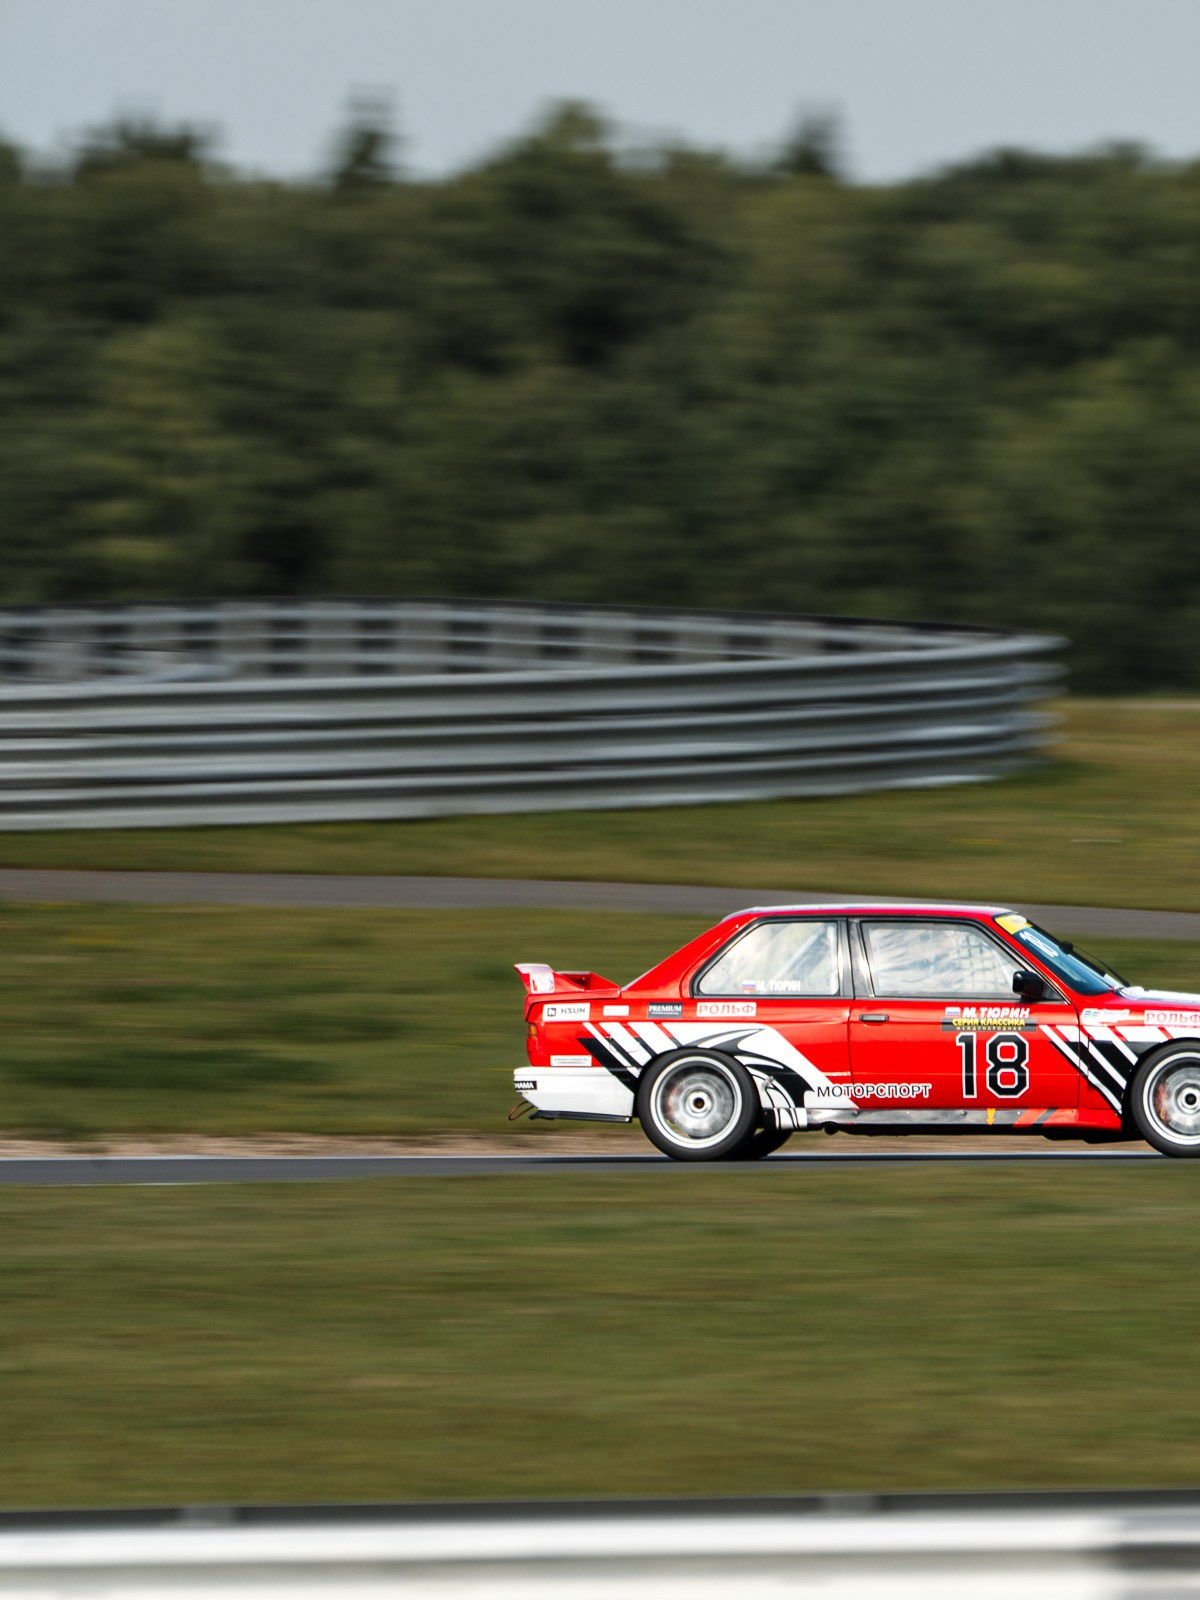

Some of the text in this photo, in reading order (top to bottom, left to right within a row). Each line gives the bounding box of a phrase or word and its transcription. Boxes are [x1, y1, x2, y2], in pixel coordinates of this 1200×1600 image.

[770, 980, 801, 991] ТЮРИН
[648, 1004, 682, 1013] PREMIUM
[699, 1004, 754, 1015] РОЛЬФ
[962, 1006, 1030, 1018] М. ТЮРИН
[952, 1018, 1025, 1026] СЕРИЯ КЛАССИКА
[955, 1032, 1029, 1098] 18
[816, 1083, 931, 1098] МОТОРСПОРТ
